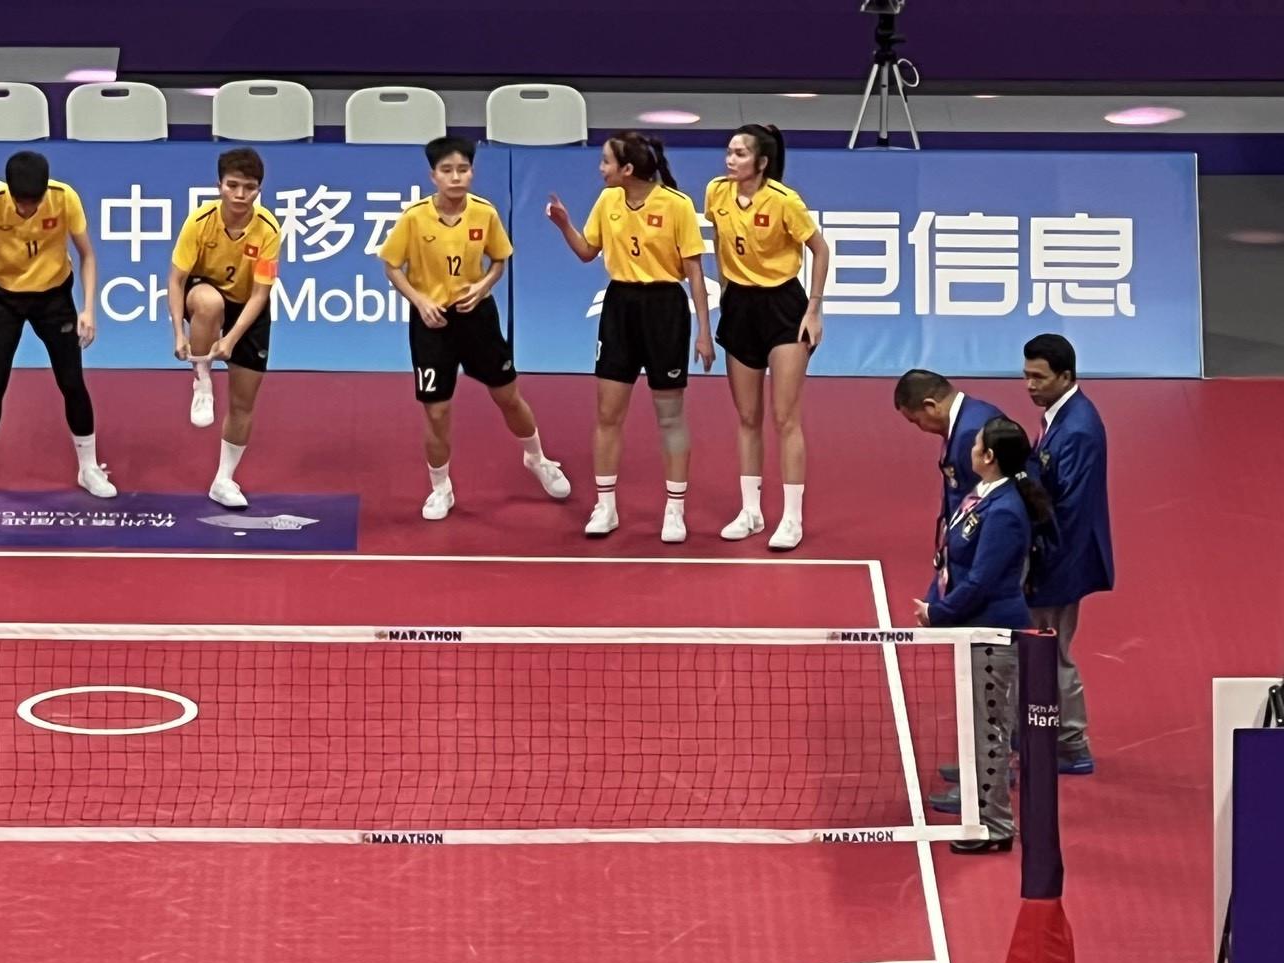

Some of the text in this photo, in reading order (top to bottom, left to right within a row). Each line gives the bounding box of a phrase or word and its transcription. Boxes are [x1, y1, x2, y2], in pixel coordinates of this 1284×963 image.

[25, 240, 39, 258] 11
[630, 236, 640, 257] 3
[735, 235, 745, 256] 5
[225, 265, 236, 284] 2
[446, 255, 462, 277] 12
[417, 366, 436, 393] 12
[388, 630, 462, 642] MARATHON
[841, 631, 914, 643] MARATHON
[371, 832, 443, 844] MARATHON
[822, 831, 894, 843] MARATHON
